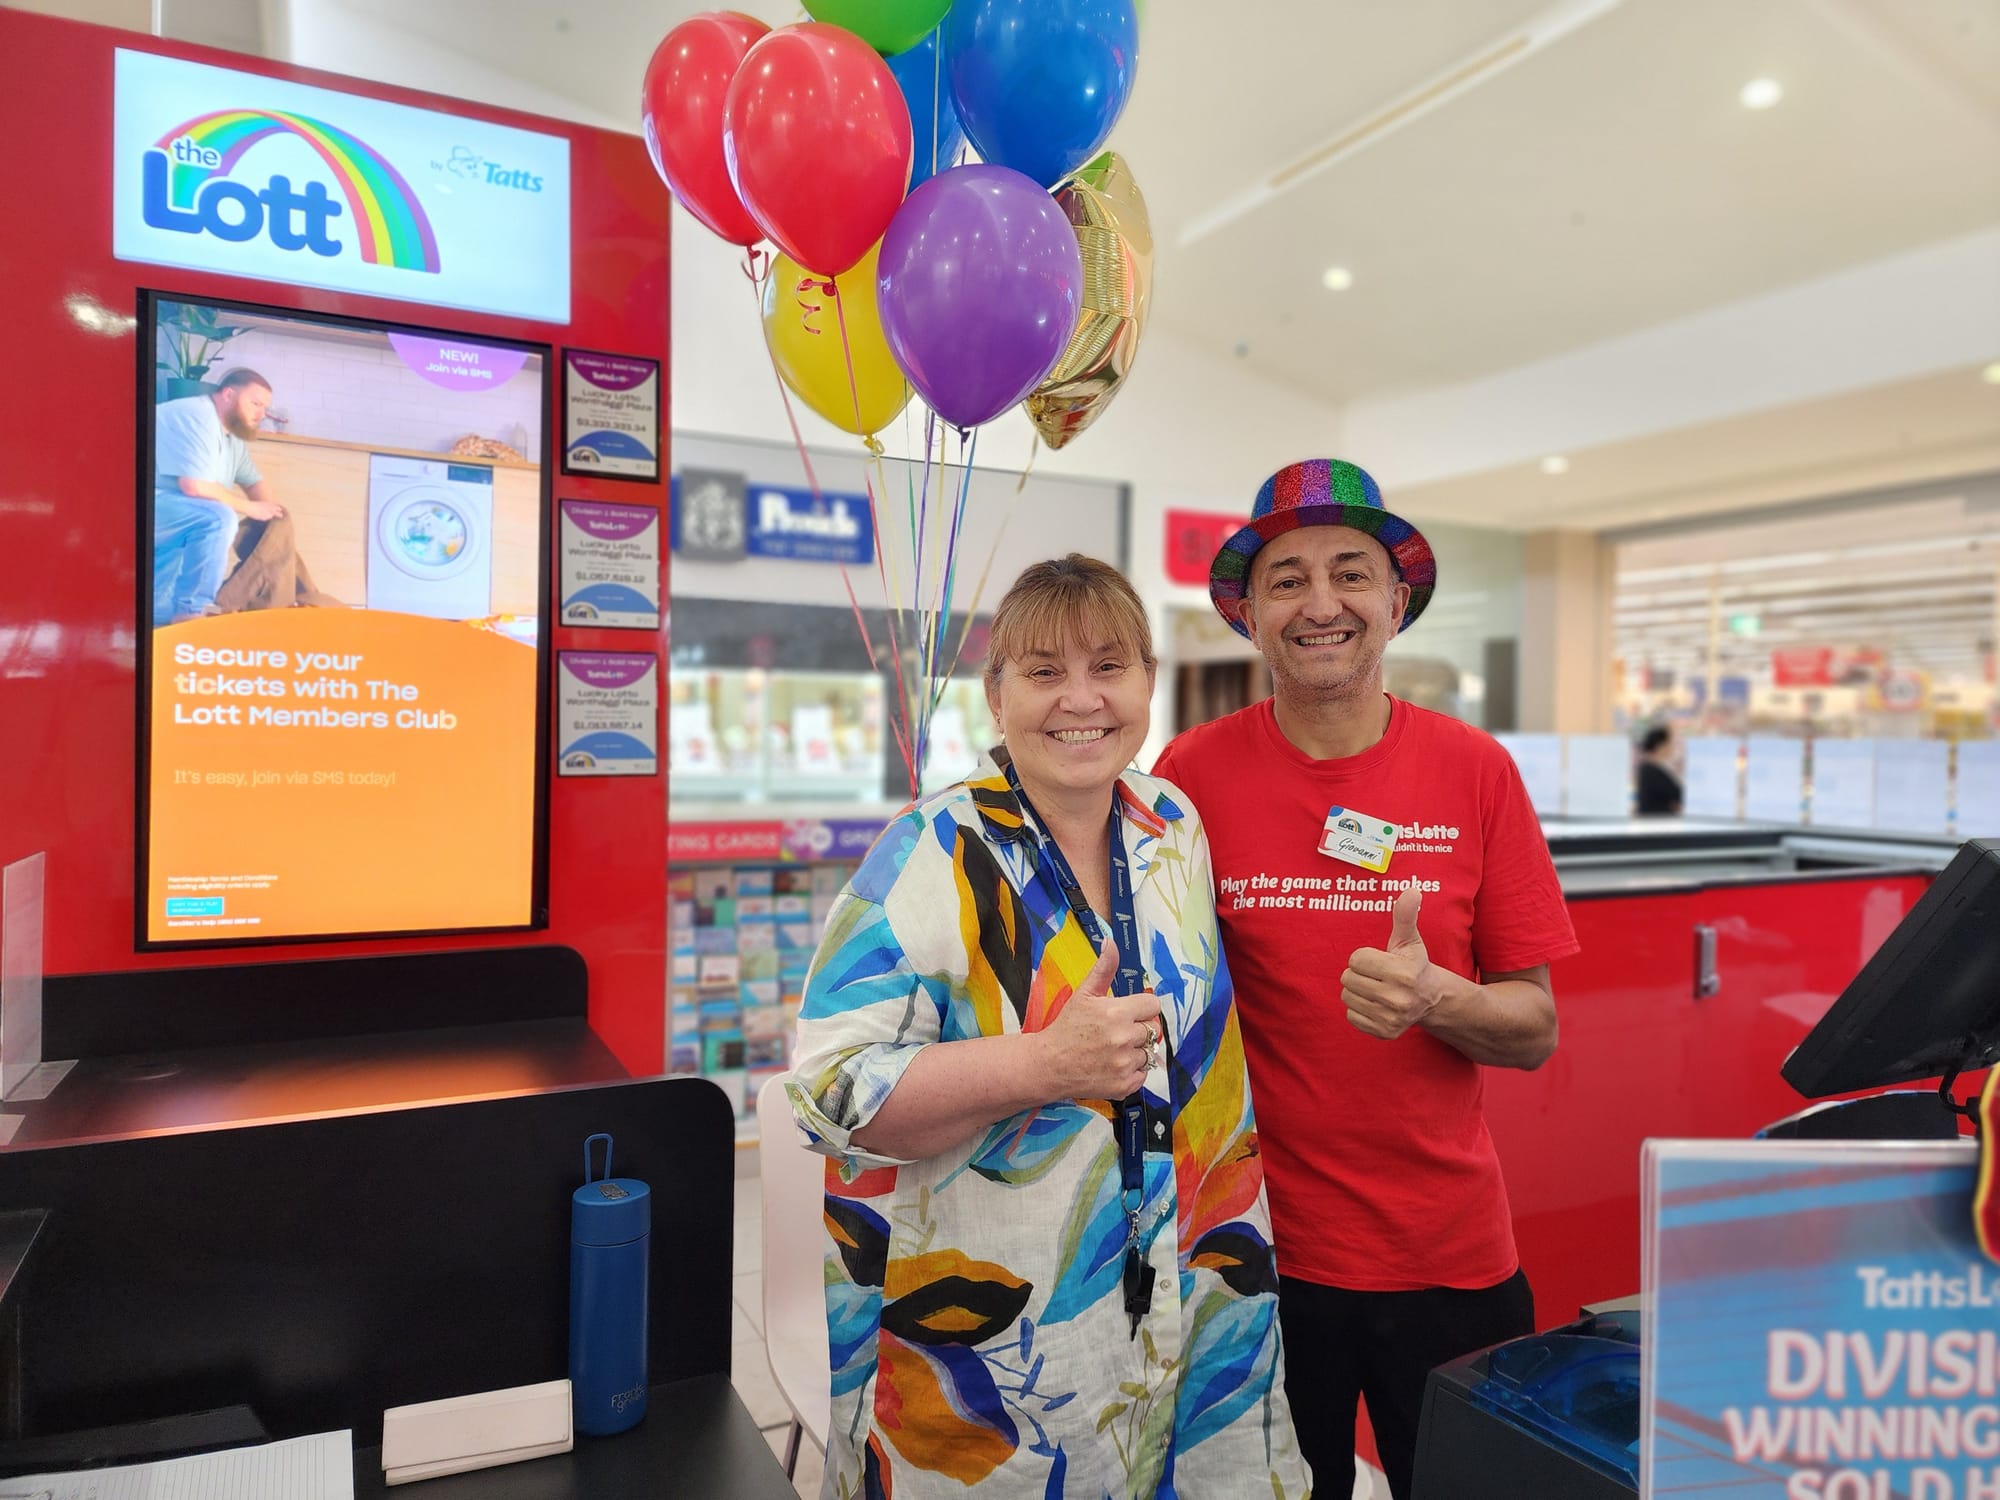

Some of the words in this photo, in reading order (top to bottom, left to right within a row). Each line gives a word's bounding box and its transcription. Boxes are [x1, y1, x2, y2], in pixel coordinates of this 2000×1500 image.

[174, 139, 218, 166] the
[483, 161, 543, 193] Tatts
[143, 150, 342, 257] Lott
[440, 348, 479, 364] NEW!
[425, 363, 449, 374] Join
[452, 366, 468, 377] via
[174, 644, 287, 668] Secure
[295, 652, 363, 674] your
[174, 672, 286, 697] tickets
[293, 677, 358, 700] with
[366, 681, 418, 701] The
[174, 704, 241, 725] Lott
[249, 706, 389, 728] Members
[396, 709, 457, 730] Club
[174, 770, 201, 785] It's
[206, 772, 248, 788] easy,
[286, 770, 308, 785] via
[312, 771, 345, 786] SMS
[348, 771, 396, 788] today!
[1339, 837, 1382, 860] Giovanni
[1423, 844, 1434, 852] be
[1435, 844, 1453, 853] nice
[1220, 876, 1248, 895] Play
[1251, 873, 1278, 889] the
[1281, 877, 1332, 893] game
[1336, 874, 1378, 891] that
[1382, 875, 1440, 892] makes
[1233, 895, 1255, 910] the
[1259, 895, 1305, 909] most
[1309, 894, 1421, 912] millionai
[1766, 1329, 2000, 1399] DIVISI
[1722, 1406, 2000, 1463] WINNING
